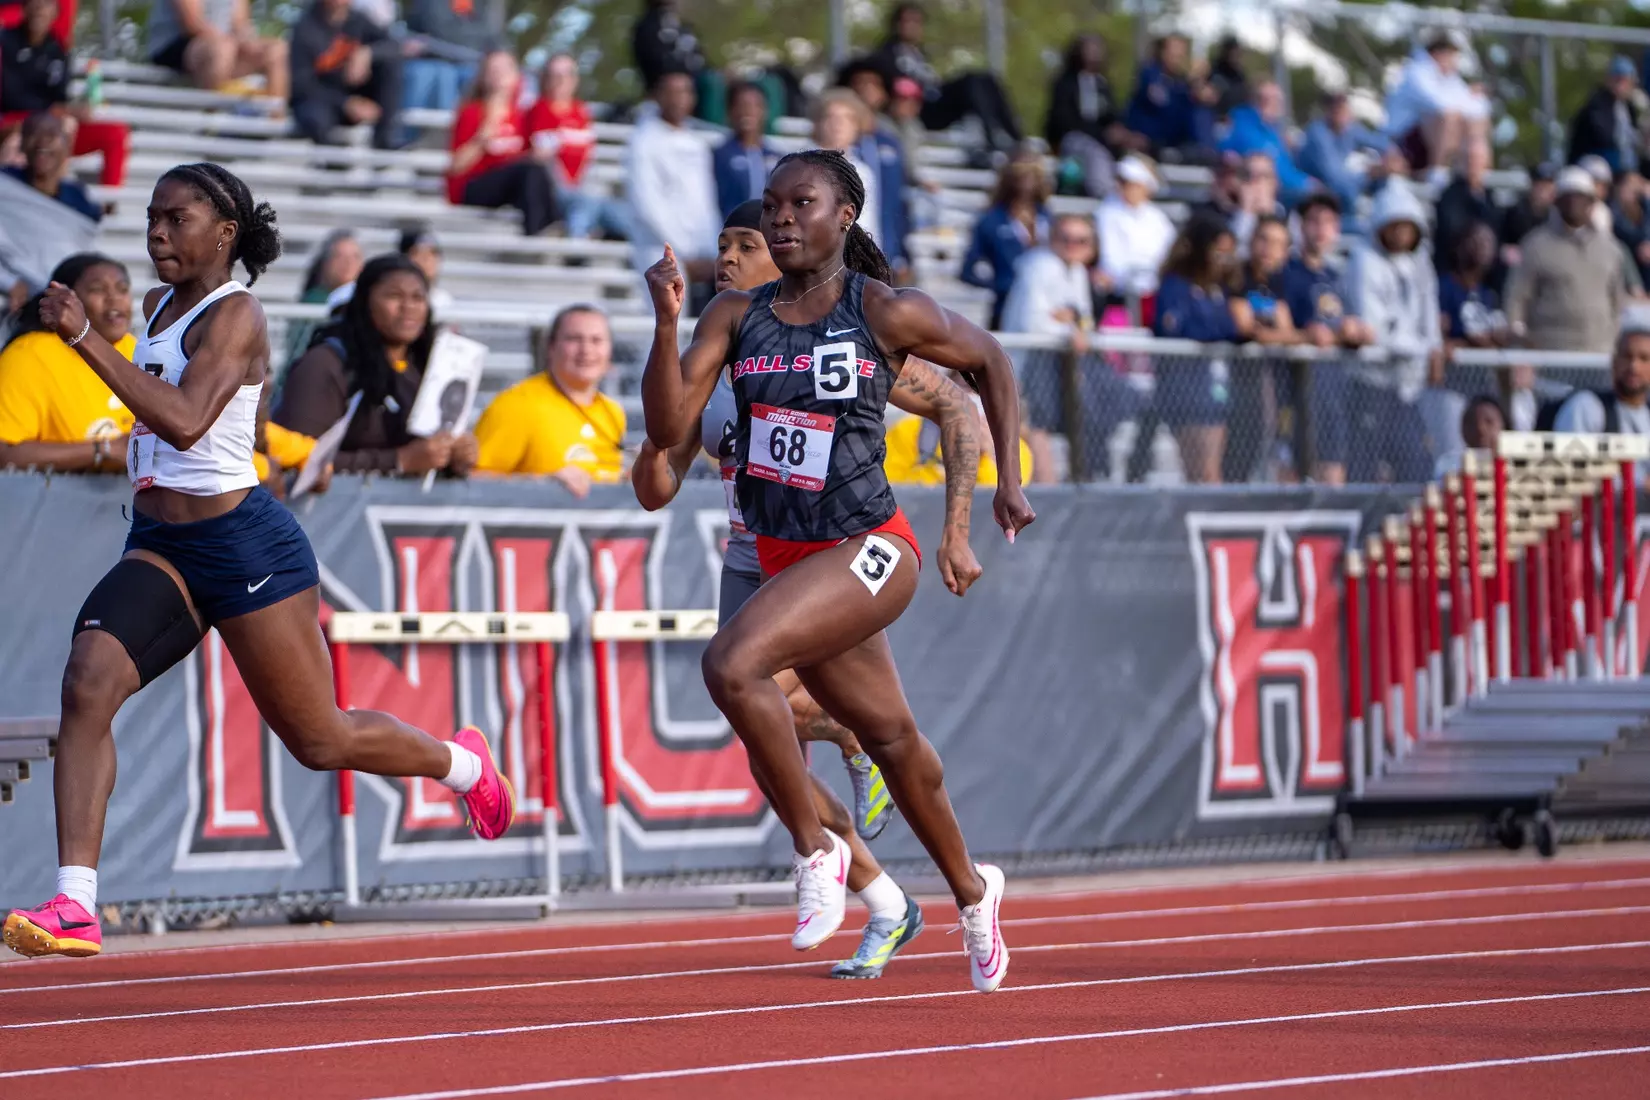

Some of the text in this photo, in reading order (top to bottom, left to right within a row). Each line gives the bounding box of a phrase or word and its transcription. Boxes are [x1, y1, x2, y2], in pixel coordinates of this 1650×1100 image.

[731, 355, 788, 382] BALL
[819, 352, 850, 393] 5
[769, 425, 807, 466] 68
[860, 544, 893, 582] 5
